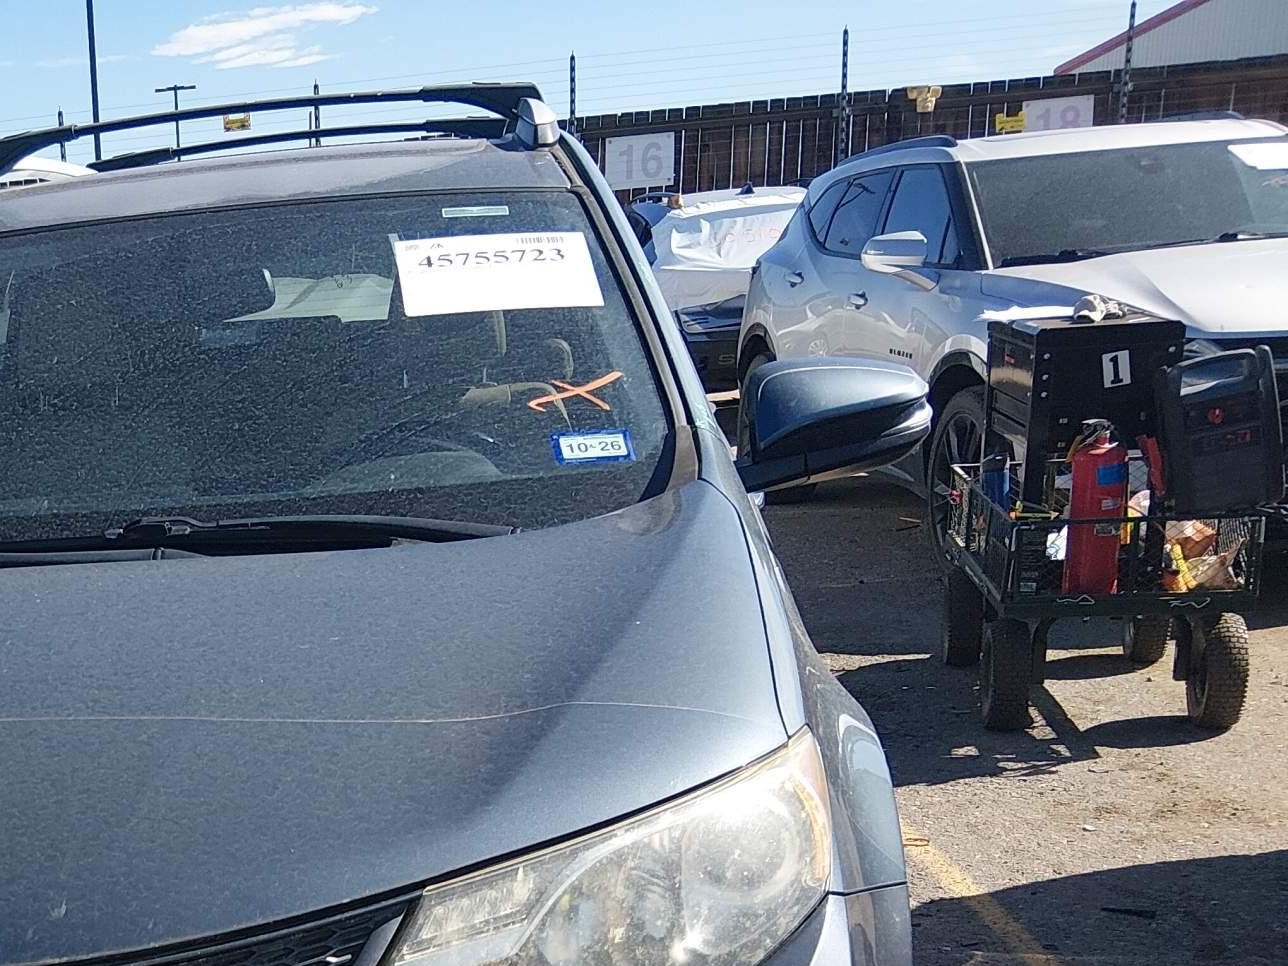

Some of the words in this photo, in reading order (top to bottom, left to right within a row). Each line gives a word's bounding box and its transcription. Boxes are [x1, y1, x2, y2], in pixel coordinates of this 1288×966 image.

[618, 141, 663, 180] 16
[417, 248, 566, 268] 45755723
[1108, 354, 1124, 385] 1
